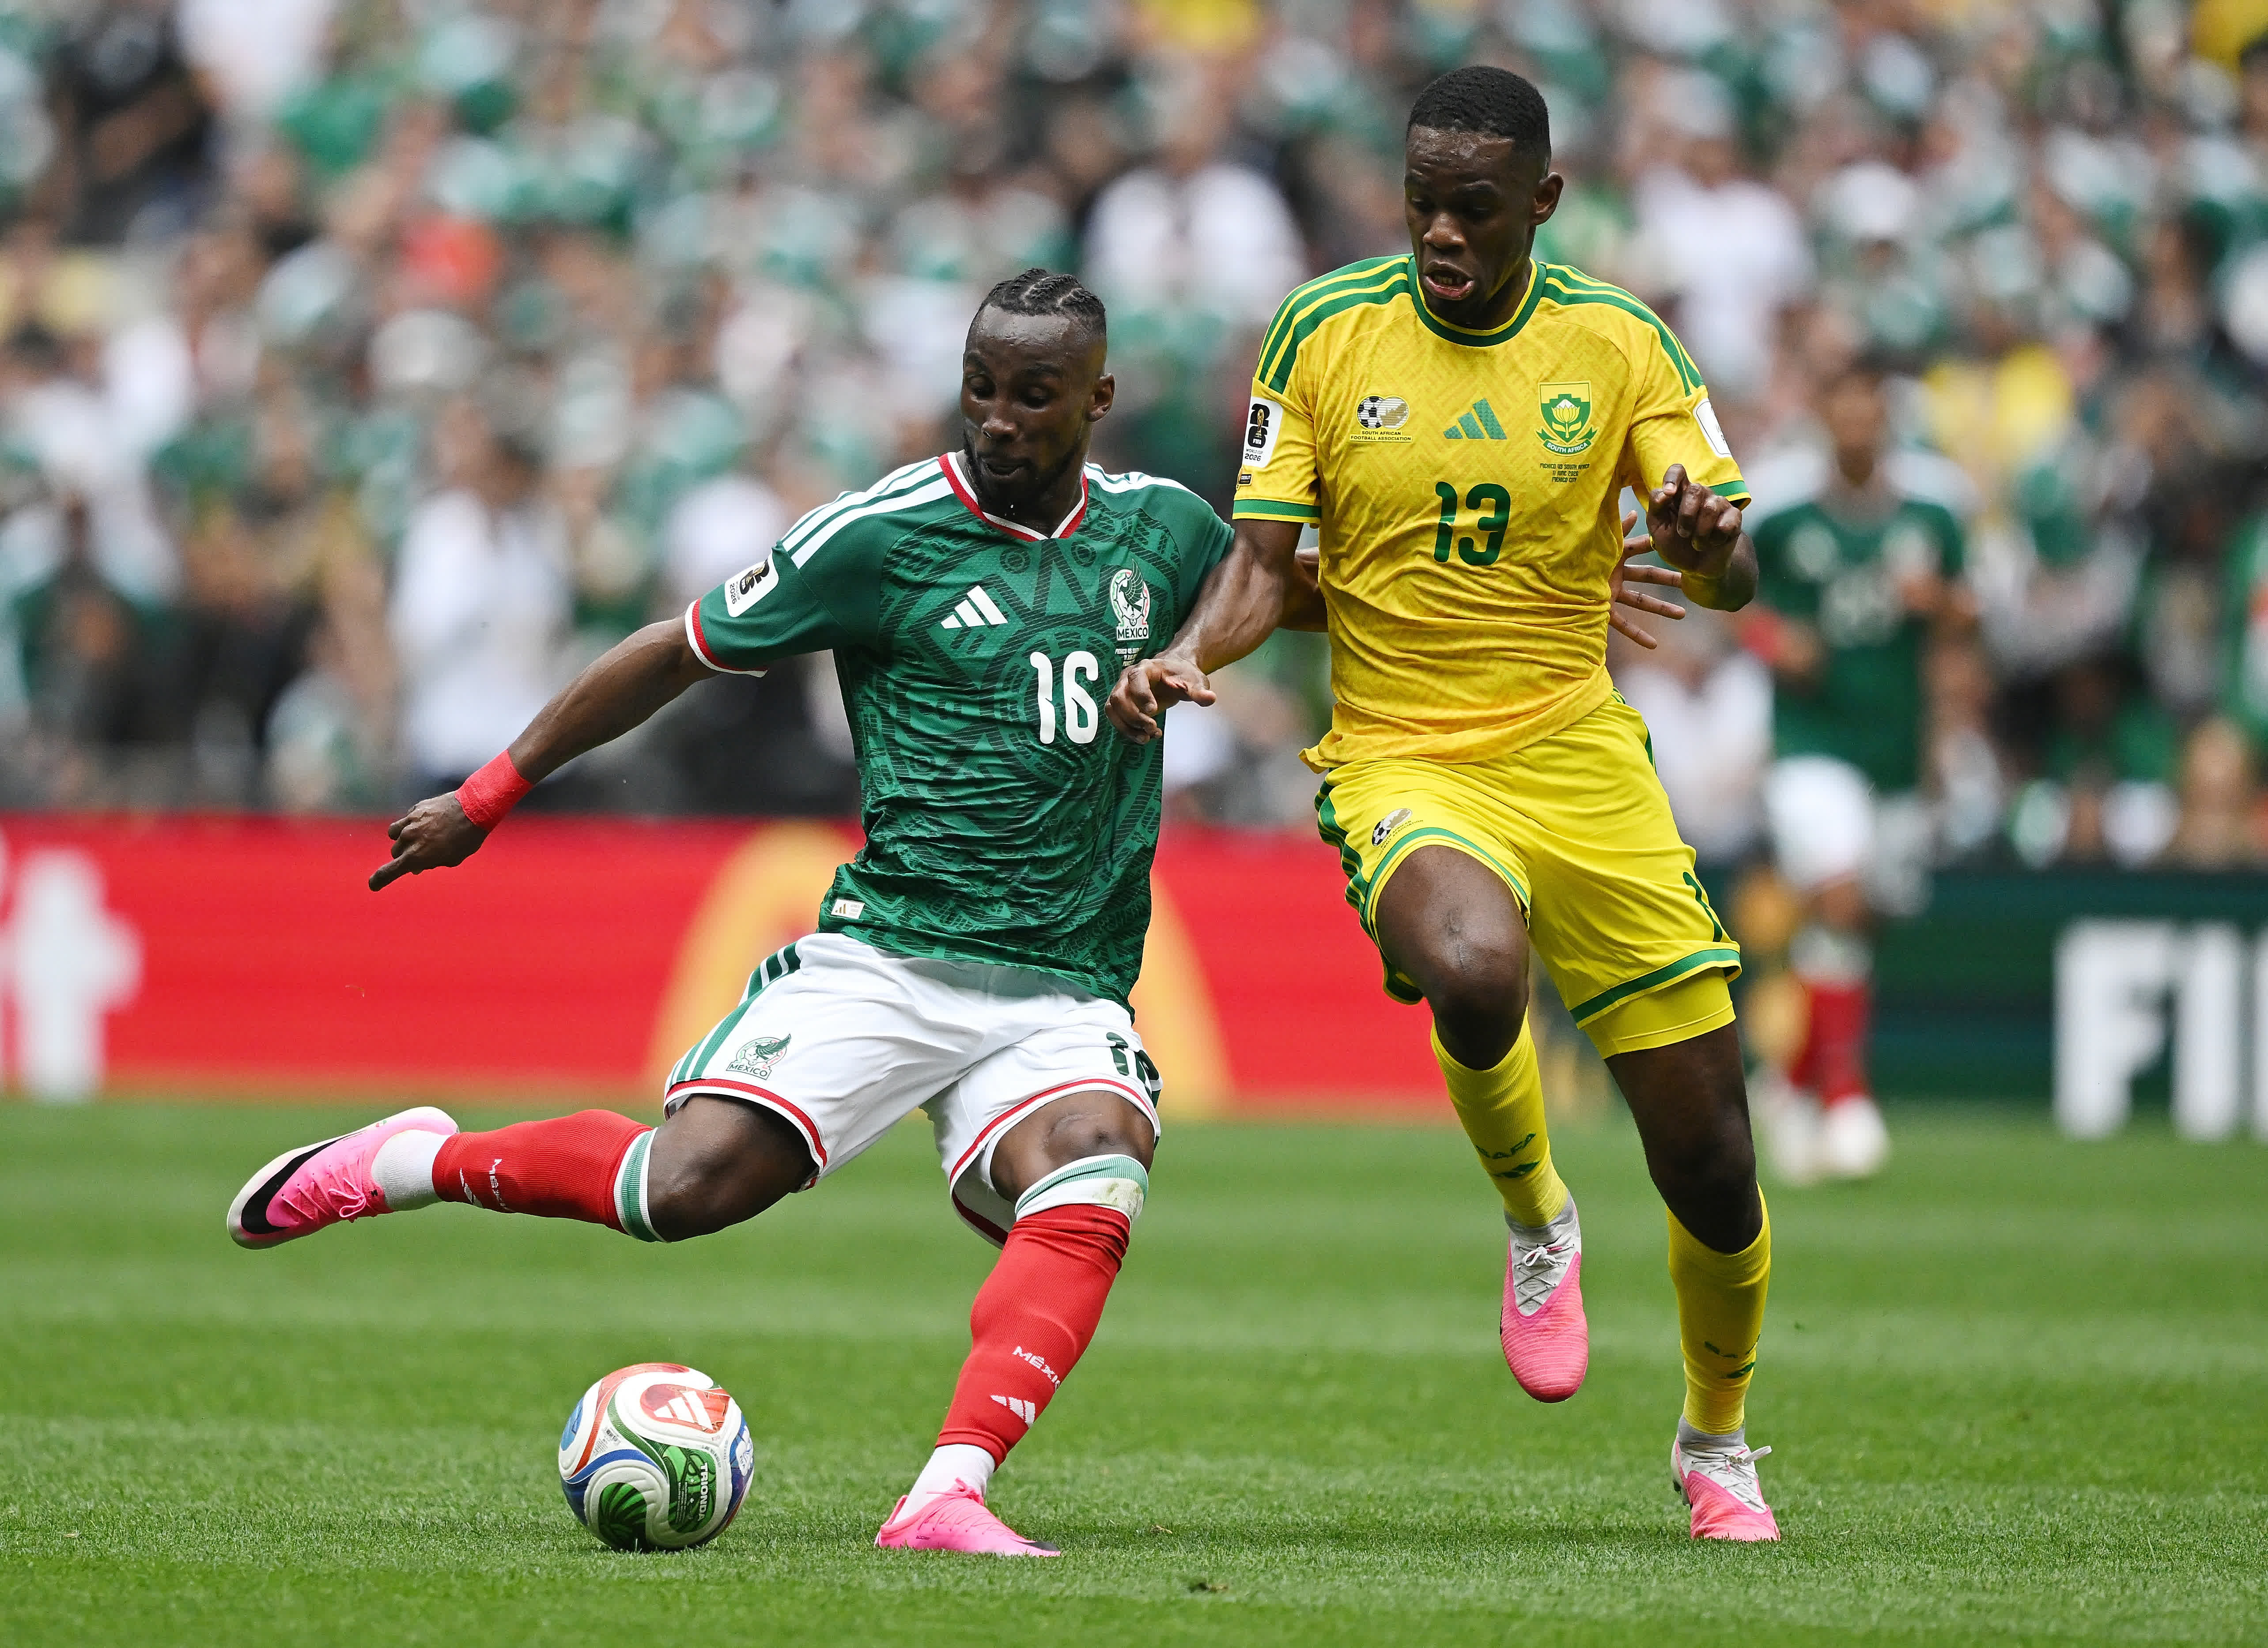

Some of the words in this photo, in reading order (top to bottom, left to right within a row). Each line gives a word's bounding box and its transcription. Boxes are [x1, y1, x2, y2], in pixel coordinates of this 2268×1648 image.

[1244, 453, 1261, 461] 2026
[1547, 442, 1566, 453] SOUTH
[1568, 442, 1588, 453] AFRICA
[1433, 481, 1511, 566] 13
[1118, 626, 1148, 639] MÉXICO
[1030, 650, 1099, 745] 16
[2053, 918, 2268, 1144] FI
[698, 1463, 708, 1521] TRIONDA
